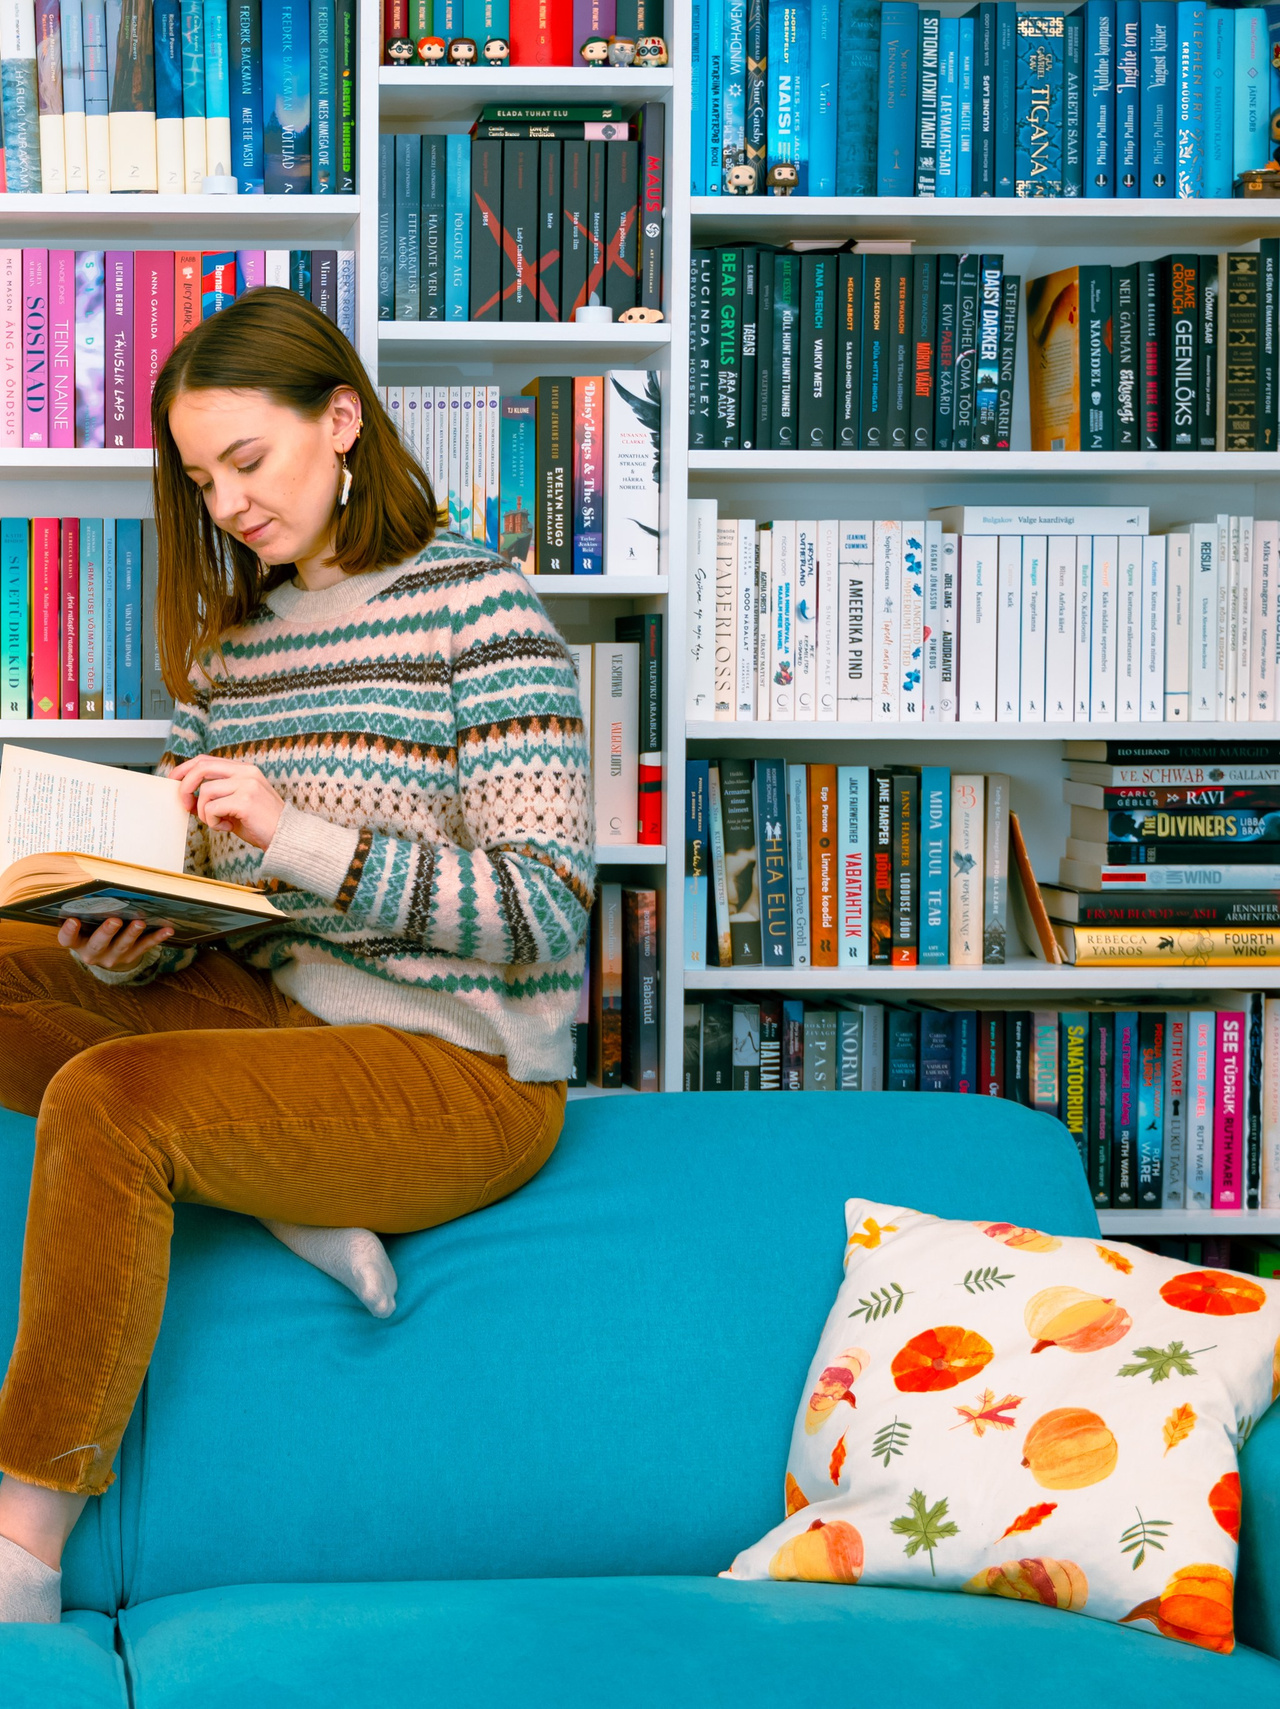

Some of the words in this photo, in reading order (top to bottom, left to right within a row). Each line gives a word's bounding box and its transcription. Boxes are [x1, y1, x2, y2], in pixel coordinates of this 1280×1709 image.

[318, 6, 329, 45] FREDRIK
[318, 48, 329, 94] BACKMAN
[1181, 42, 1190, 79] KREEKA
[318, 100, 329, 119] MEES
[751, 80, 764, 105] Suur
[778, 76, 791, 134] NAISI
[1067, 72, 1078, 126] AARETE
[1181, 81, 1190, 120] MÜÜDID
[497, 110, 522, 118] ELADA
[525, 110, 550, 118] TUHAT
[553, 110, 568, 118] ELU
[751, 108, 764, 145] Gatsby
[1026, 84, 1050, 176] TIGANA
[318, 121, 329, 148] NIMEGA
[1067, 130, 1078, 165] SAAR
[318, 151, 329, 166] OVE
[646, 155, 660, 212] MAUS
[515, 227, 523, 241] Lady
[515, 243, 523, 277] Chatterley
[721, 253, 735, 297] BEAR
[515, 279, 523, 303] armuke
[701, 259, 710, 347] LUCINDA
[981, 270, 1000, 307] DAISY
[1003, 283, 1017, 342] STEPHEN
[54, 320, 69, 368] TEINE
[721, 305, 735, 365] GRYLLS
[981, 310, 1000, 360] DARKER
[26, 296, 45, 413] SOSINAD
[113, 331, 125, 385] TÄIUSLIK
[813, 339, 823, 369] VAIKIV
[1001, 347, 1013, 380] KING
[1174, 320, 1195, 425] GEENILÕKS
[54, 375, 69, 430] NAINE
[580, 381, 596, 419] Daisy
[701, 361, 710, 417] RILEY
[813, 372, 823, 398] METS
[113, 389, 125, 421] LAPS
[997, 389, 1010, 437] CARRIE
[580, 421, 596, 459] Jones
[580, 463, 596, 473] &
[553, 467, 563, 509] EVELYN
[580, 478, 596, 498] The
[553, 514, 563, 547] HUGO
[580, 501, 596, 528] Six
[86, 562, 96, 616] ARMASTUSE
[975, 560, 983, 586] Atwood
[8, 556, 22, 689] SUVETÜDRUKUD
[715, 557, 733, 691] PABERLOSS
[848, 579, 863, 644] AMEERIKA
[975, 591, 983, 624] Kassisilm
[1029, 591, 1038, 632] Tangerlanna
[86, 619, 96, 665] VÕIMATUD
[86, 668, 96, 690] TÕED
[848, 650, 863, 680] PIND
[877, 778, 890, 802] JANE
[1186, 791, 1224, 804] RAVI
[877, 805, 890, 845] HARPER
[928, 791, 942, 829] MIDA
[1158, 813, 1237, 837] DIVINERS
[821, 853, 831, 892] Linnutee
[928, 841, 942, 877] TUUL
[821, 895, 831, 928] koodid
[845, 853, 862, 937] VABATAHTLIK
[928, 889, 942, 926] TEAB
[1087, 936, 1147, 944] REBECCA
[1092, 946, 1143, 955] YARROS
[1225, 934, 1274, 944] FOURTH
[1233, 946, 1267, 956] WING
[643, 976, 655, 1024] Rabatud
[1222, 1020, 1239, 1053] SEE
[1066, 1026, 1084, 1133] SANATOORIUM
[1222, 1056, 1239, 1114] TÜDRUK
[1222, 1118, 1233, 1149] RUTH
[1222, 1151, 1233, 1186] WARE
